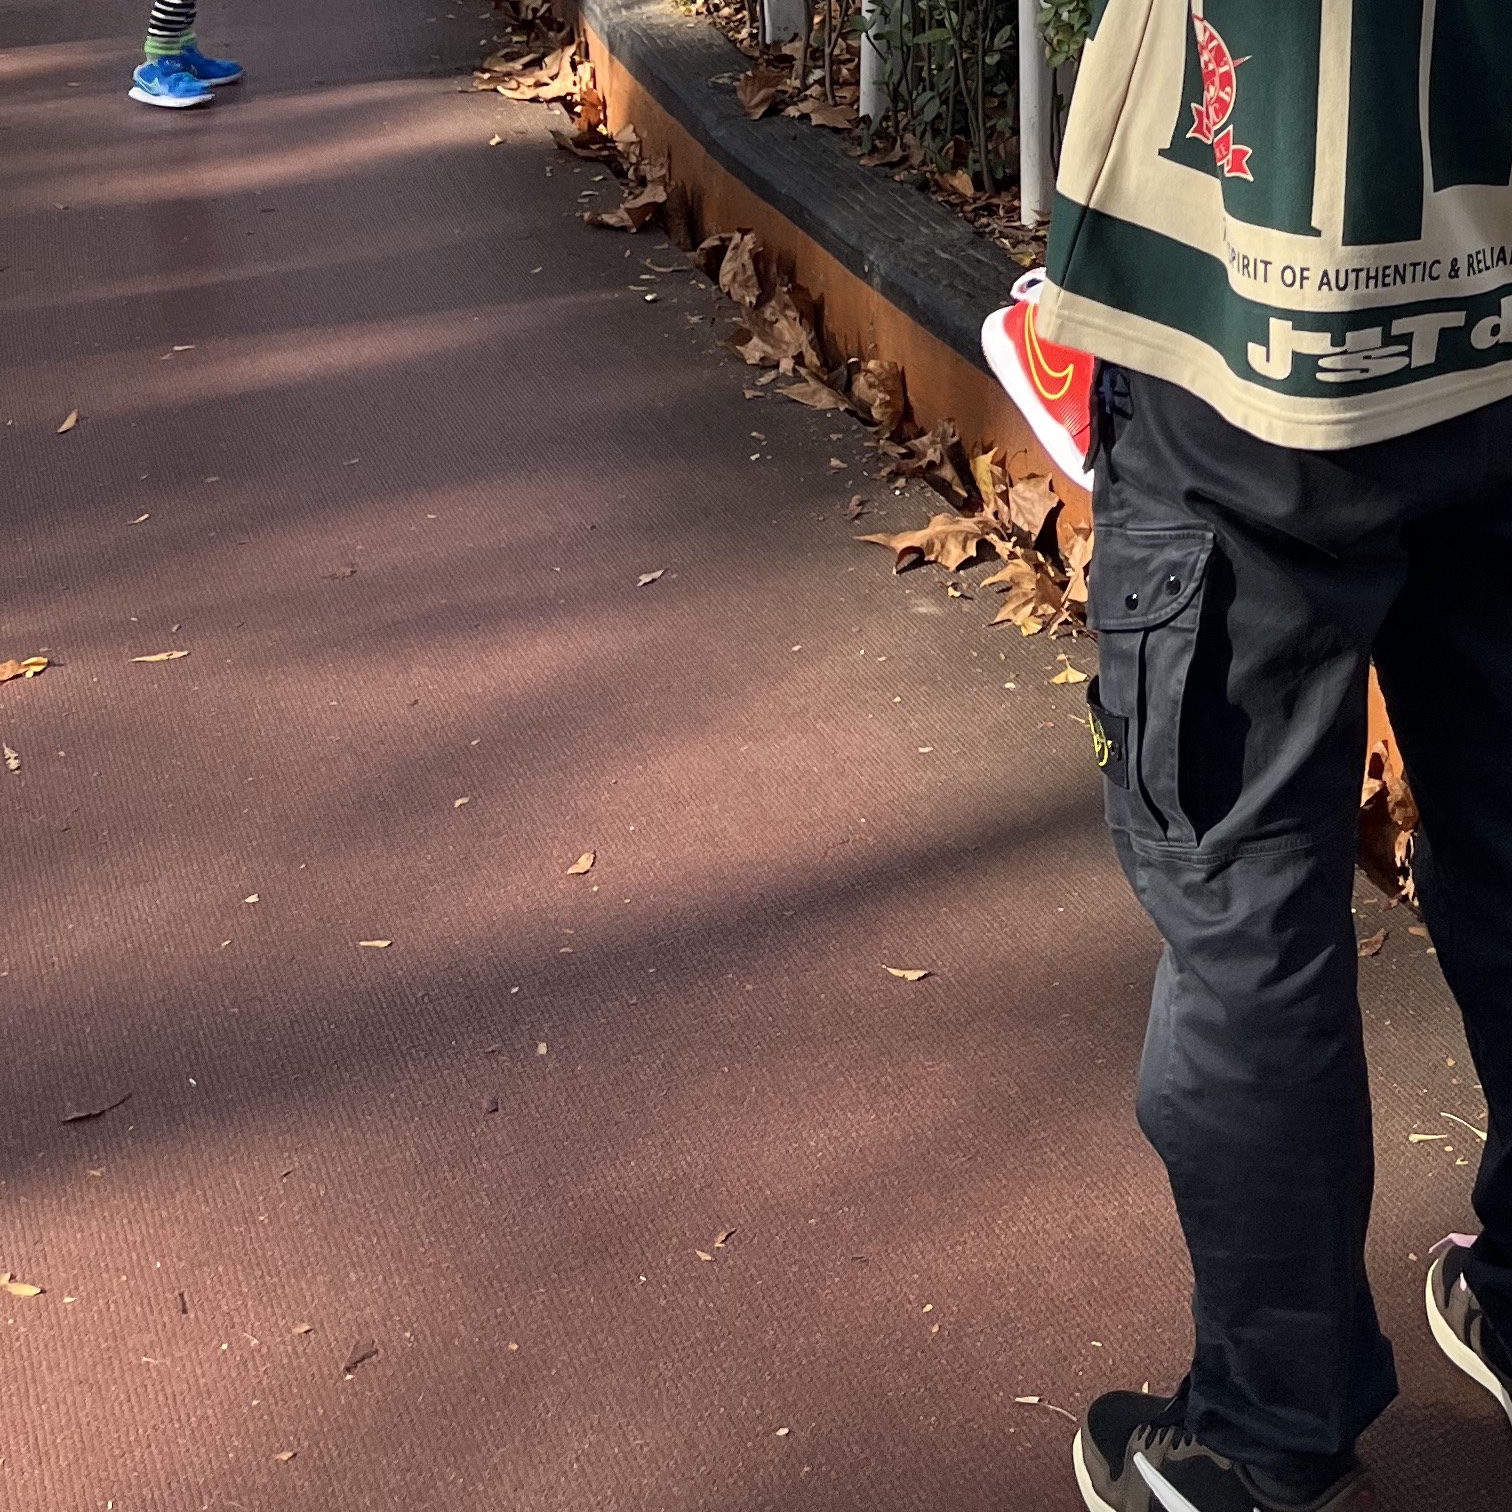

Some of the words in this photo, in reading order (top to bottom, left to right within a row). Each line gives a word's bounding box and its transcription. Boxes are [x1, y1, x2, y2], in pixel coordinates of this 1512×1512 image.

[1227, 244, 1272, 283] PIRIT
[1280, 264, 1310, 289] OF
[1317, 259, 1441, 292] AUTHENTIC
[1448, 257, 1460, 279] &
